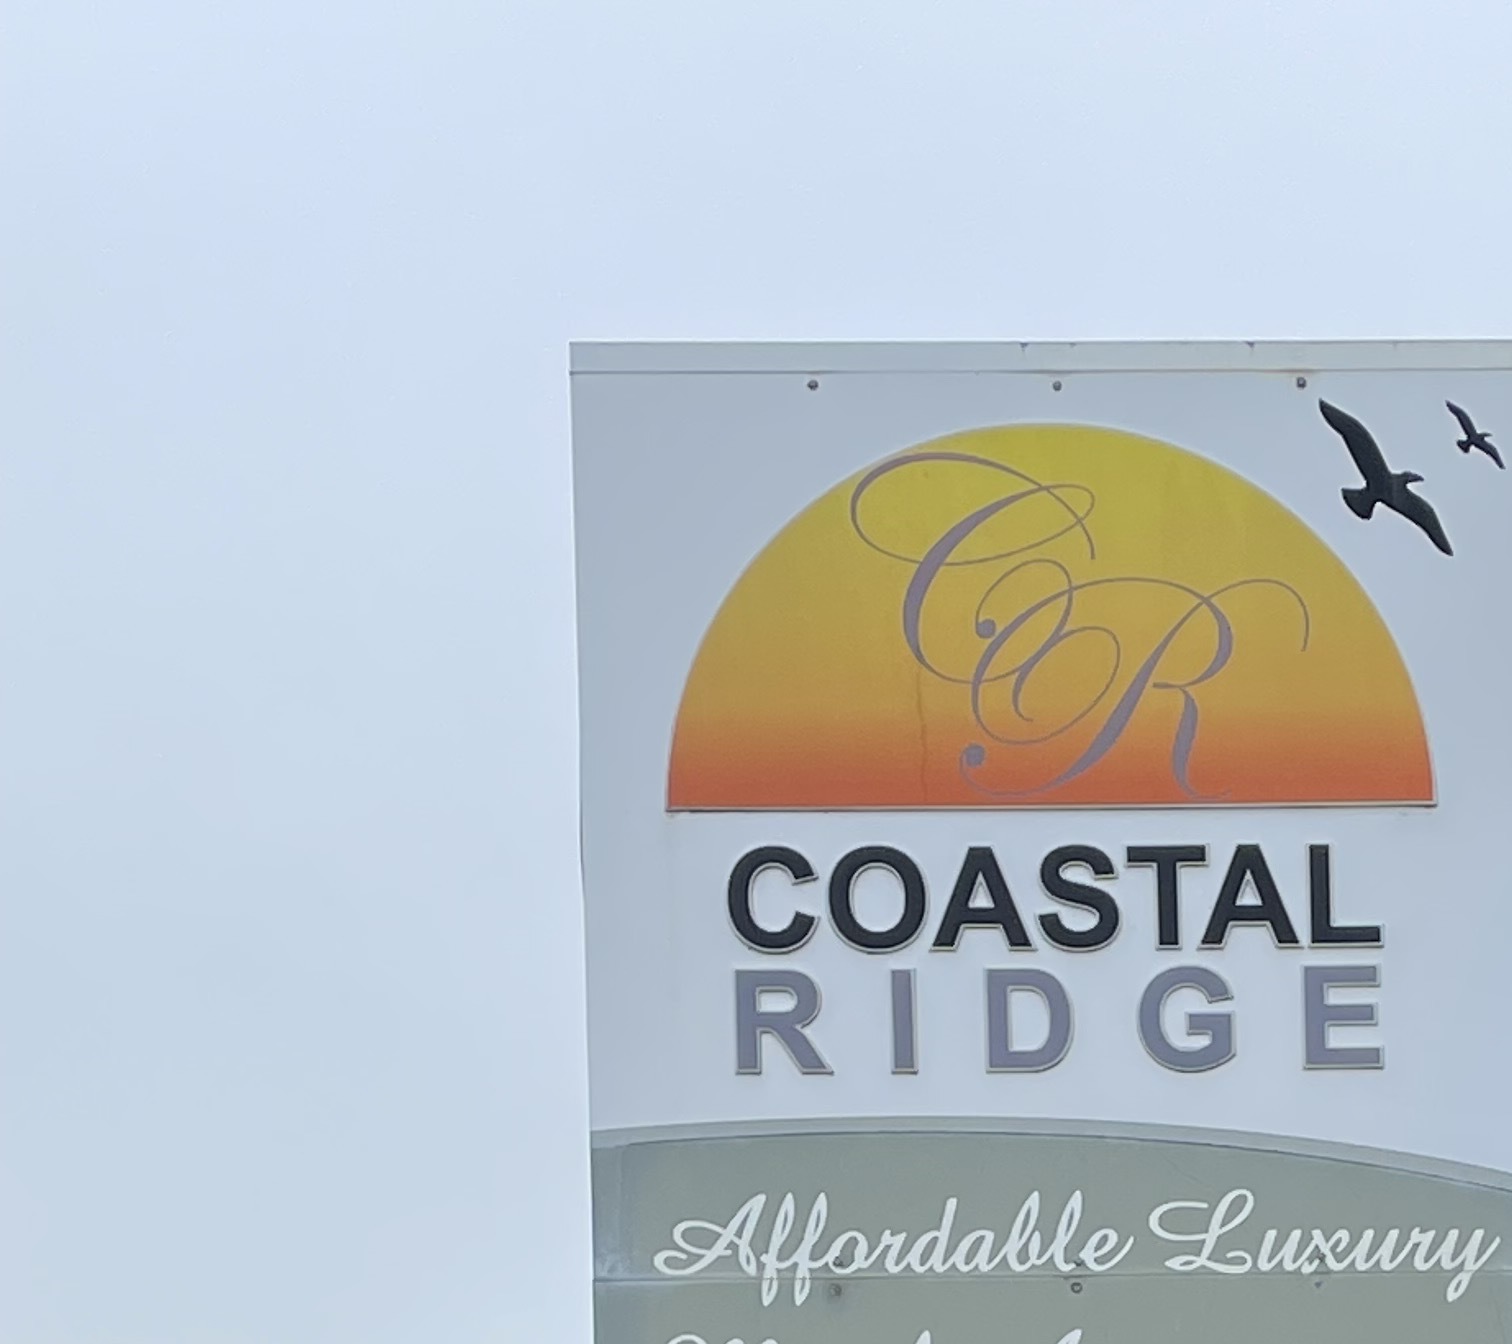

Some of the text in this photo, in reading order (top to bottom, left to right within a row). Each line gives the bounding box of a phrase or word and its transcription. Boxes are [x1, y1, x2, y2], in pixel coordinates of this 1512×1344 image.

[726, 843, 1385, 954] COASTAL
[732, 963, 1386, 1076] RIDGE
[653, 1188, 1501, 1307] Affordable Luxury
